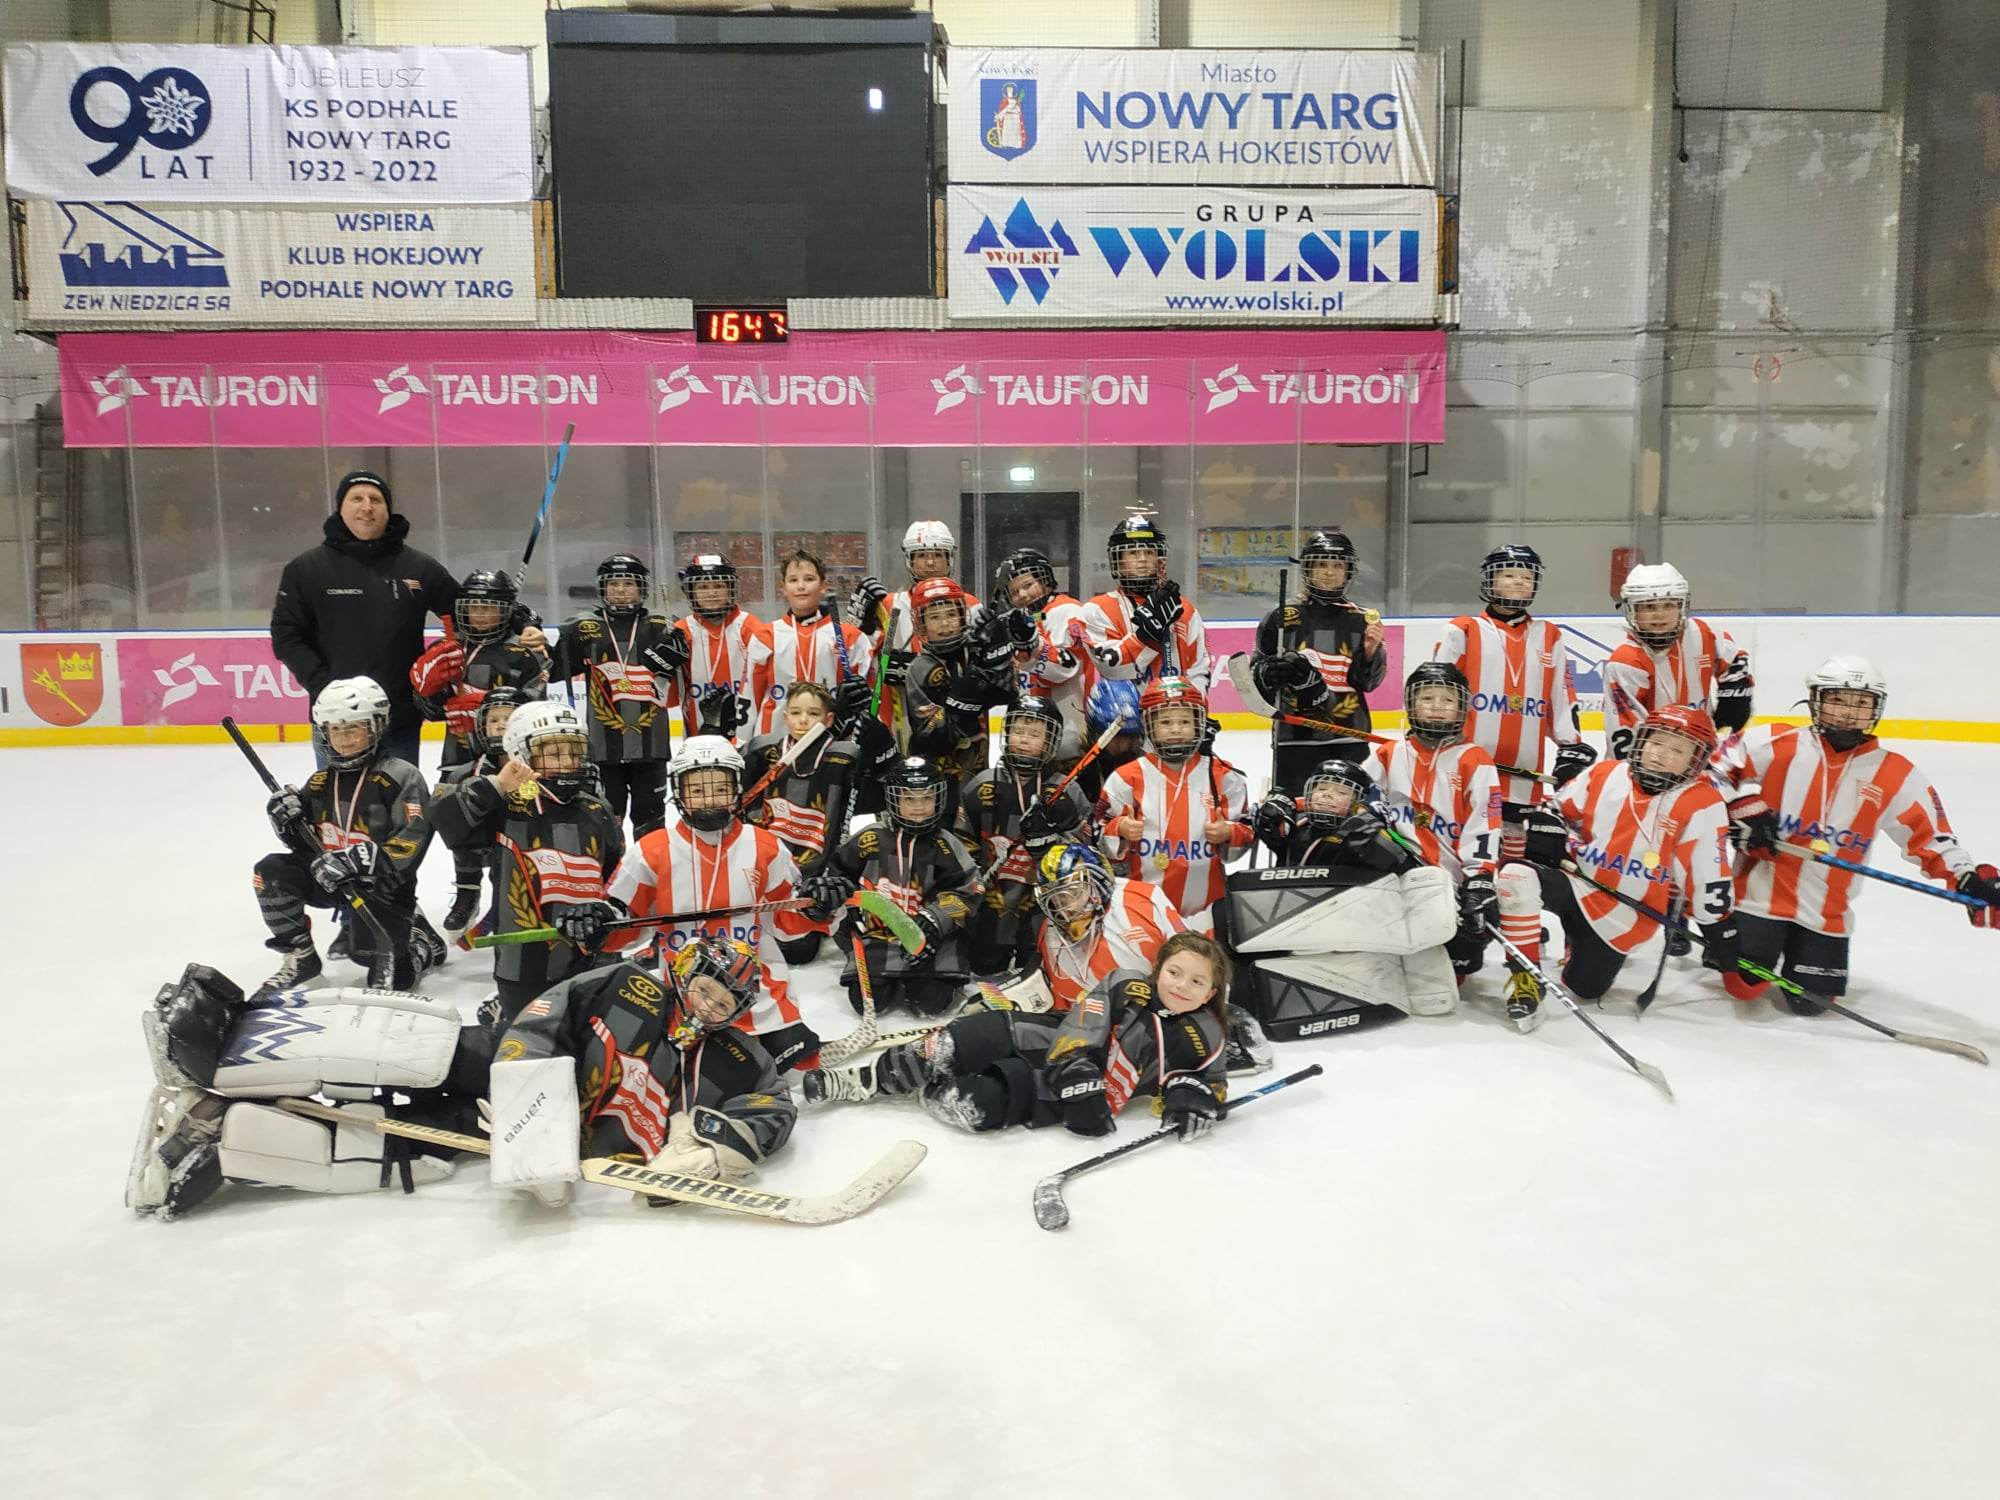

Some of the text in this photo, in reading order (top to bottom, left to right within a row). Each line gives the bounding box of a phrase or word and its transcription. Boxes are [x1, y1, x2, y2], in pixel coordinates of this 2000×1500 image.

[284, 67, 426, 89] JUBILEUSZ
[1201, 62, 1277, 84] Miasto
[285, 100, 458, 119] KS PODHALE
[1076, 91, 1398, 131] NOWY TARG
[287, 131, 451, 150] NOWY TARG
[1084, 136, 1392, 165] WSPIERA HOKEISTÓW
[141, 156, 214, 180] LAT
[289, 161, 345, 182] 1932
[373, 161, 438, 182] 2022
[336, 213, 434, 232] WSPIERA
[1197, 205, 1314, 223] GRUPA
[289, 247, 483, 266] KLUB HOKEJOWY
[984, 248, 1061, 266] WOLSKI
[1088, 227, 1420, 282] WOLSKI
[260, 280, 514, 299] PODHALE NOWY TARG
[63, 295, 231, 311] ZEW NIEDZICA SA
[1165, 291, 1344, 317] www.wolski.pl
[151, 375, 318, 407] TAURON
[434, 374, 598, 406] TAURON
[714, 375, 873, 406] TAURON
[988, 375, 1149, 406] TAURON
[1261, 373, 1420, 406] TAURON
[224, 664, 310, 698] TAU
[1612, 729, 1633, 760] 2
[1775, 811, 1873, 855] MARCH
[536, 854, 557, 866] KS
[1138, 838, 1214, 860] OMARC
[1260, 868, 1330, 881] BAUER
[1704, 880, 1732, 914] 3
[362, 988, 434, 1003] VAUGHN
[1299, 1014, 1360, 1036] BAUER
[627, 1064, 649, 1087] KS
[504, 1092, 547, 1144] BAUER
